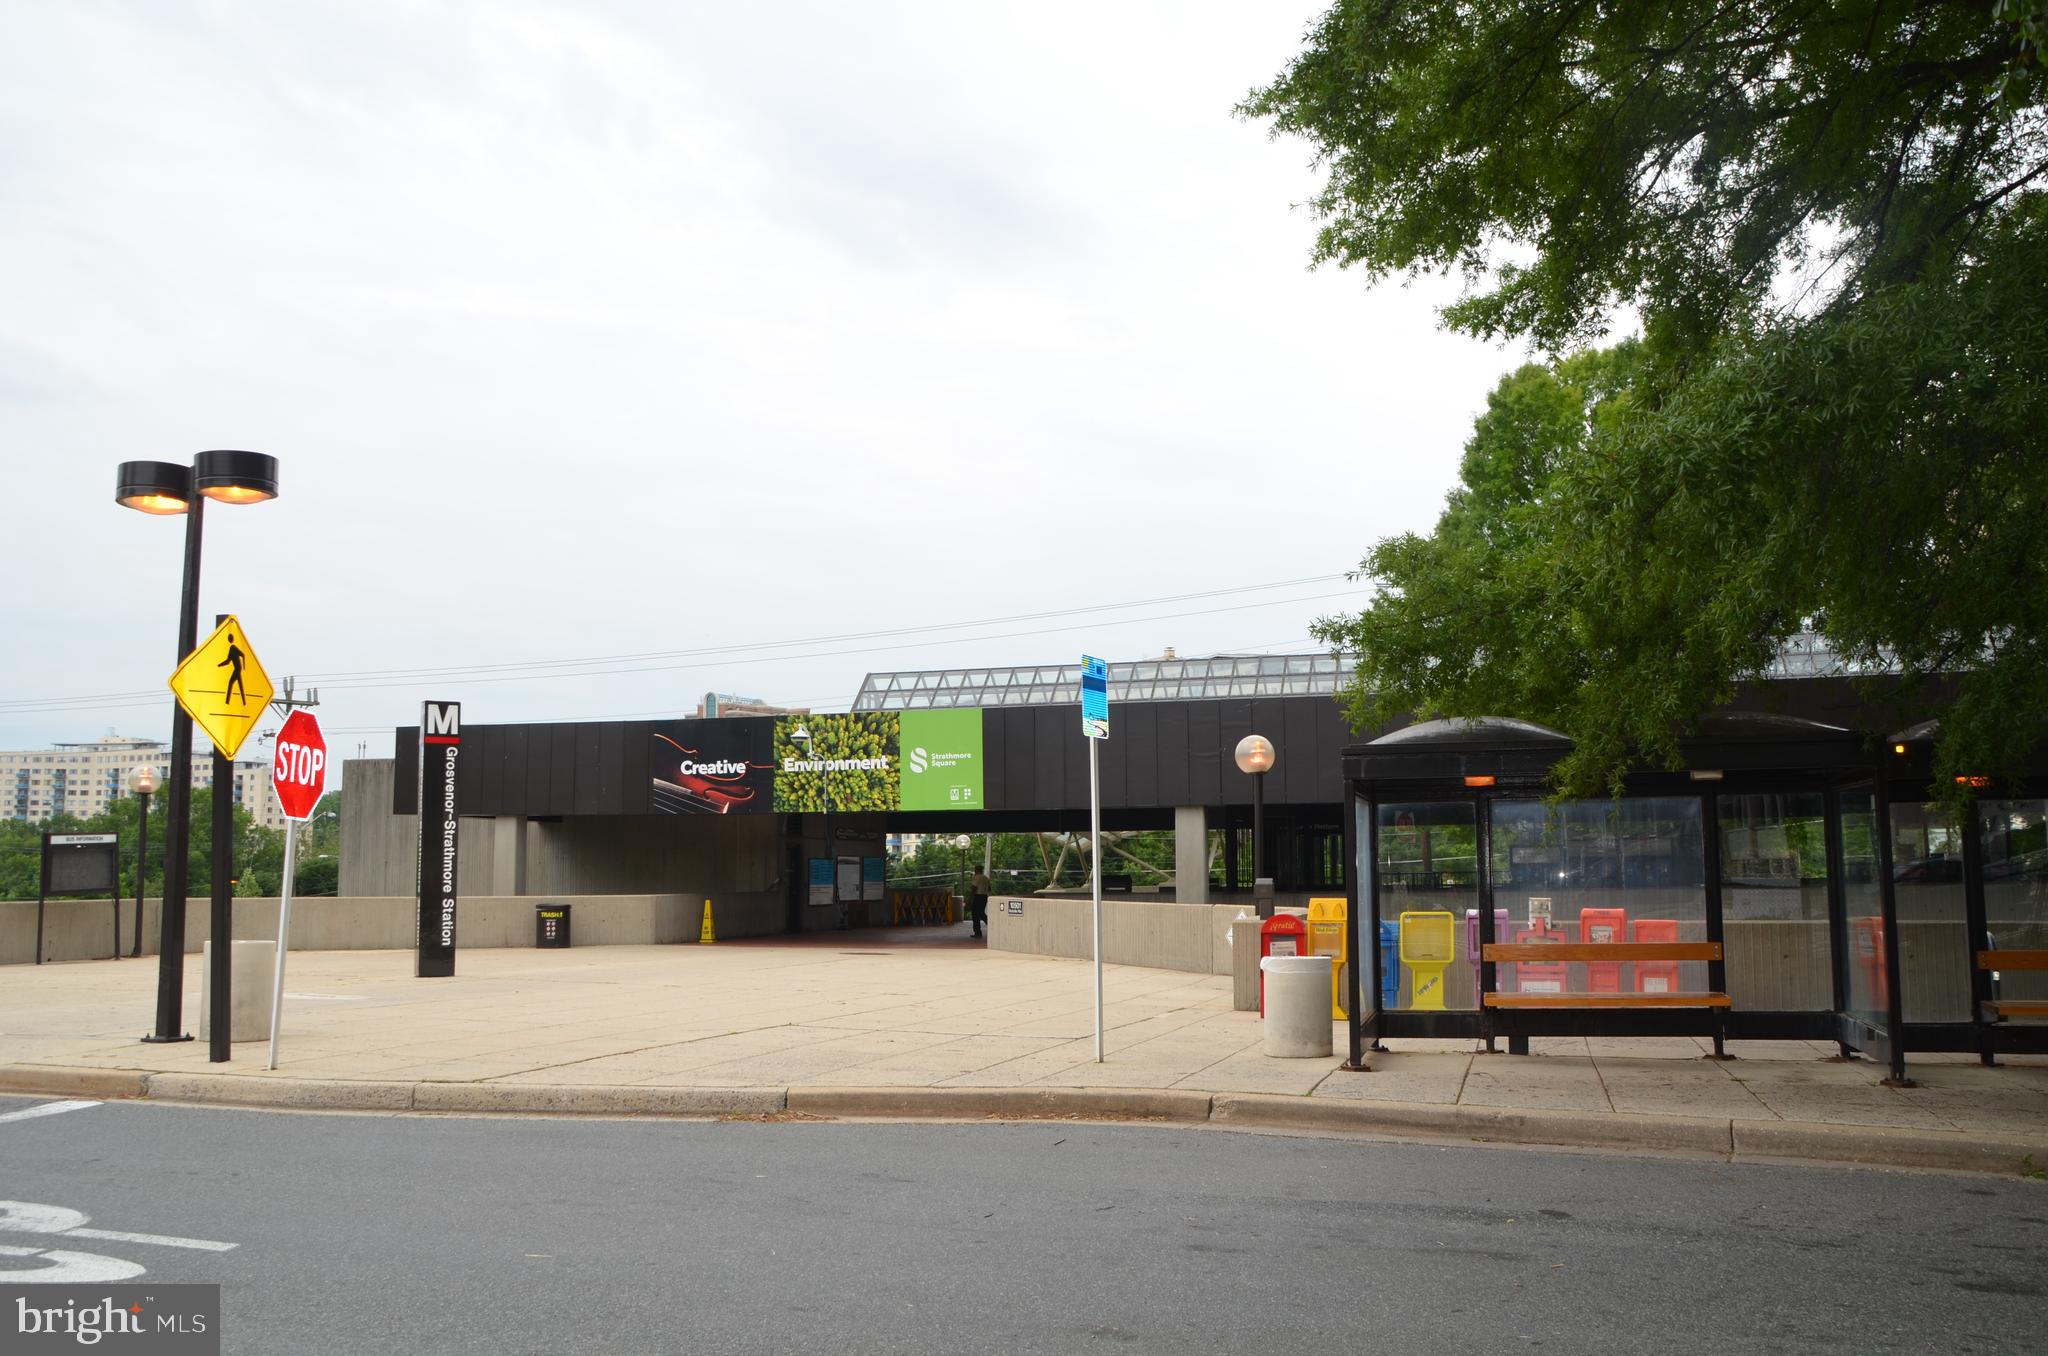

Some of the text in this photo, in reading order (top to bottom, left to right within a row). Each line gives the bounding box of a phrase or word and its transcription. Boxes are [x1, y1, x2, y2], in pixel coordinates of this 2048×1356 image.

[427, 704, 459, 735] M
[276, 741, 324, 787] STOP
[680, 759, 746, 776] Creative
[784, 755, 889, 772] Environment
[931, 760, 957, 768] Square
[441, 746, 459, 946] Grosvenor-Strathmore Station
